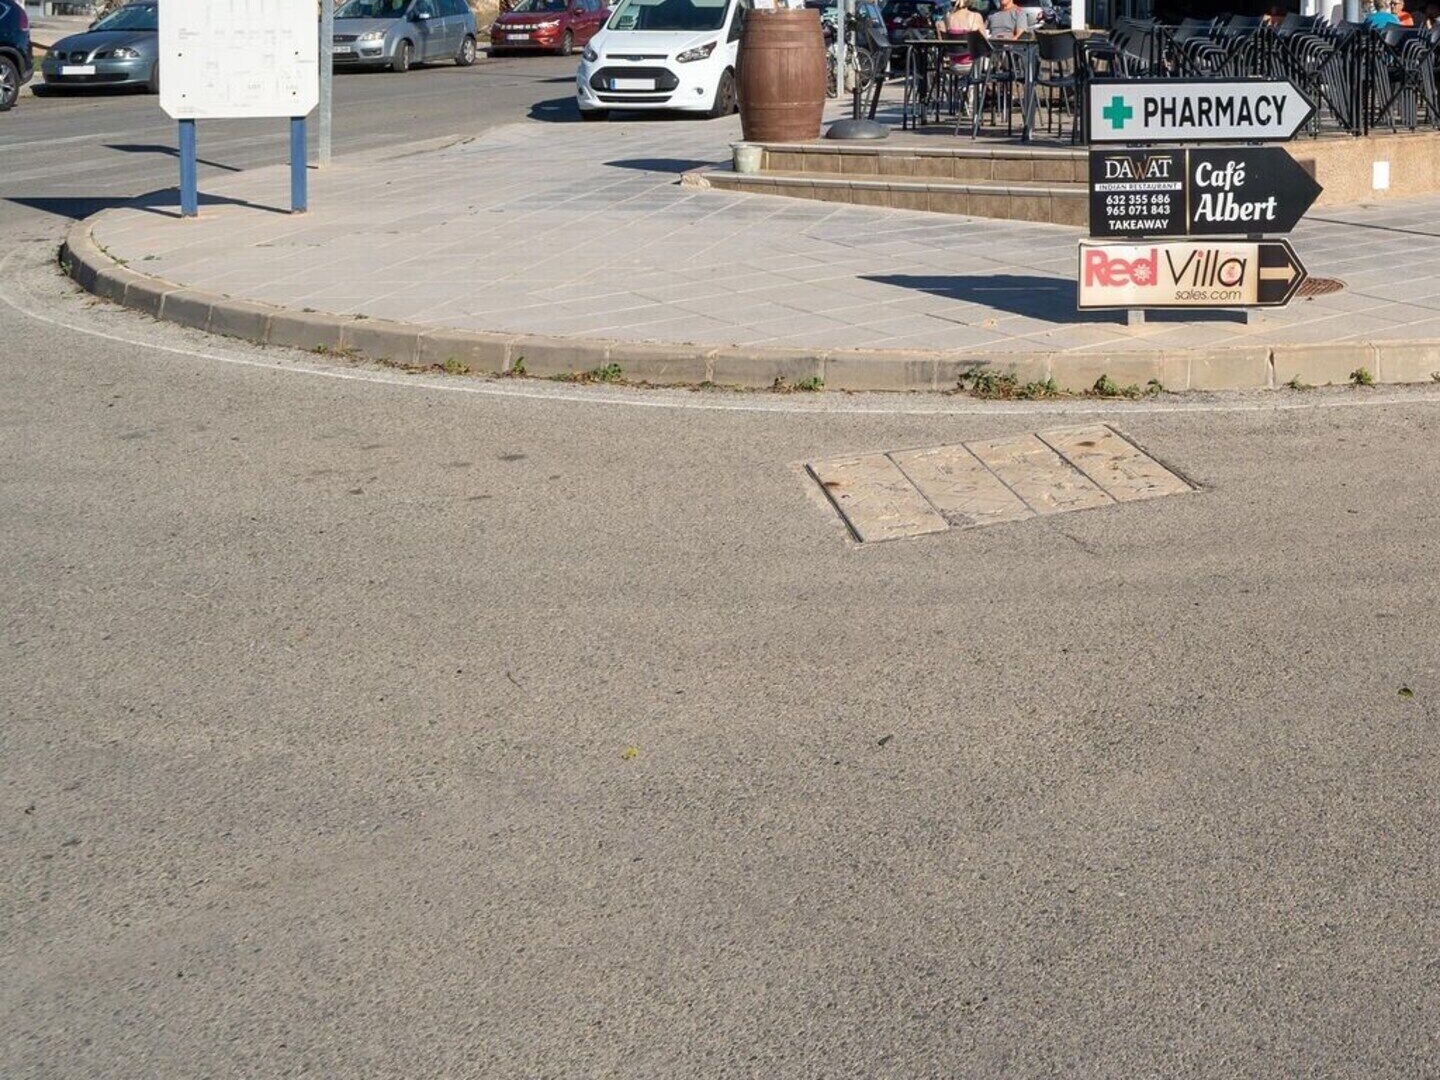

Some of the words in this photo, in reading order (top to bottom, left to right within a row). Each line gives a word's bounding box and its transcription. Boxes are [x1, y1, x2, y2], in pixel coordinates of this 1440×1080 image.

[1143, 95, 1287, 128] PHARMACY
[1105, 158, 1172, 180] DAWAT
[1195, 161, 1245, 191] Café
[1099, 183, 1127, 192] INDIAN
[1128, 182, 1178, 191] RESTAURANT
[1106, 195, 1126, 205] 632
[1128, 194, 1148, 205] 355
[1151, 194, 1171, 204] 686
[1194, 192, 1278, 222] Albert
[1106, 206, 1126, 216] 965
[1128, 205, 1148, 216] 071
[1151, 205, 1171, 215] 843
[1108, 219, 1169, 230] TAKEAWAY
[1085, 248, 1158, 287] Red
[1165, 249, 1247, 287] Villa
[1174, 289, 1242, 301] sales.com
